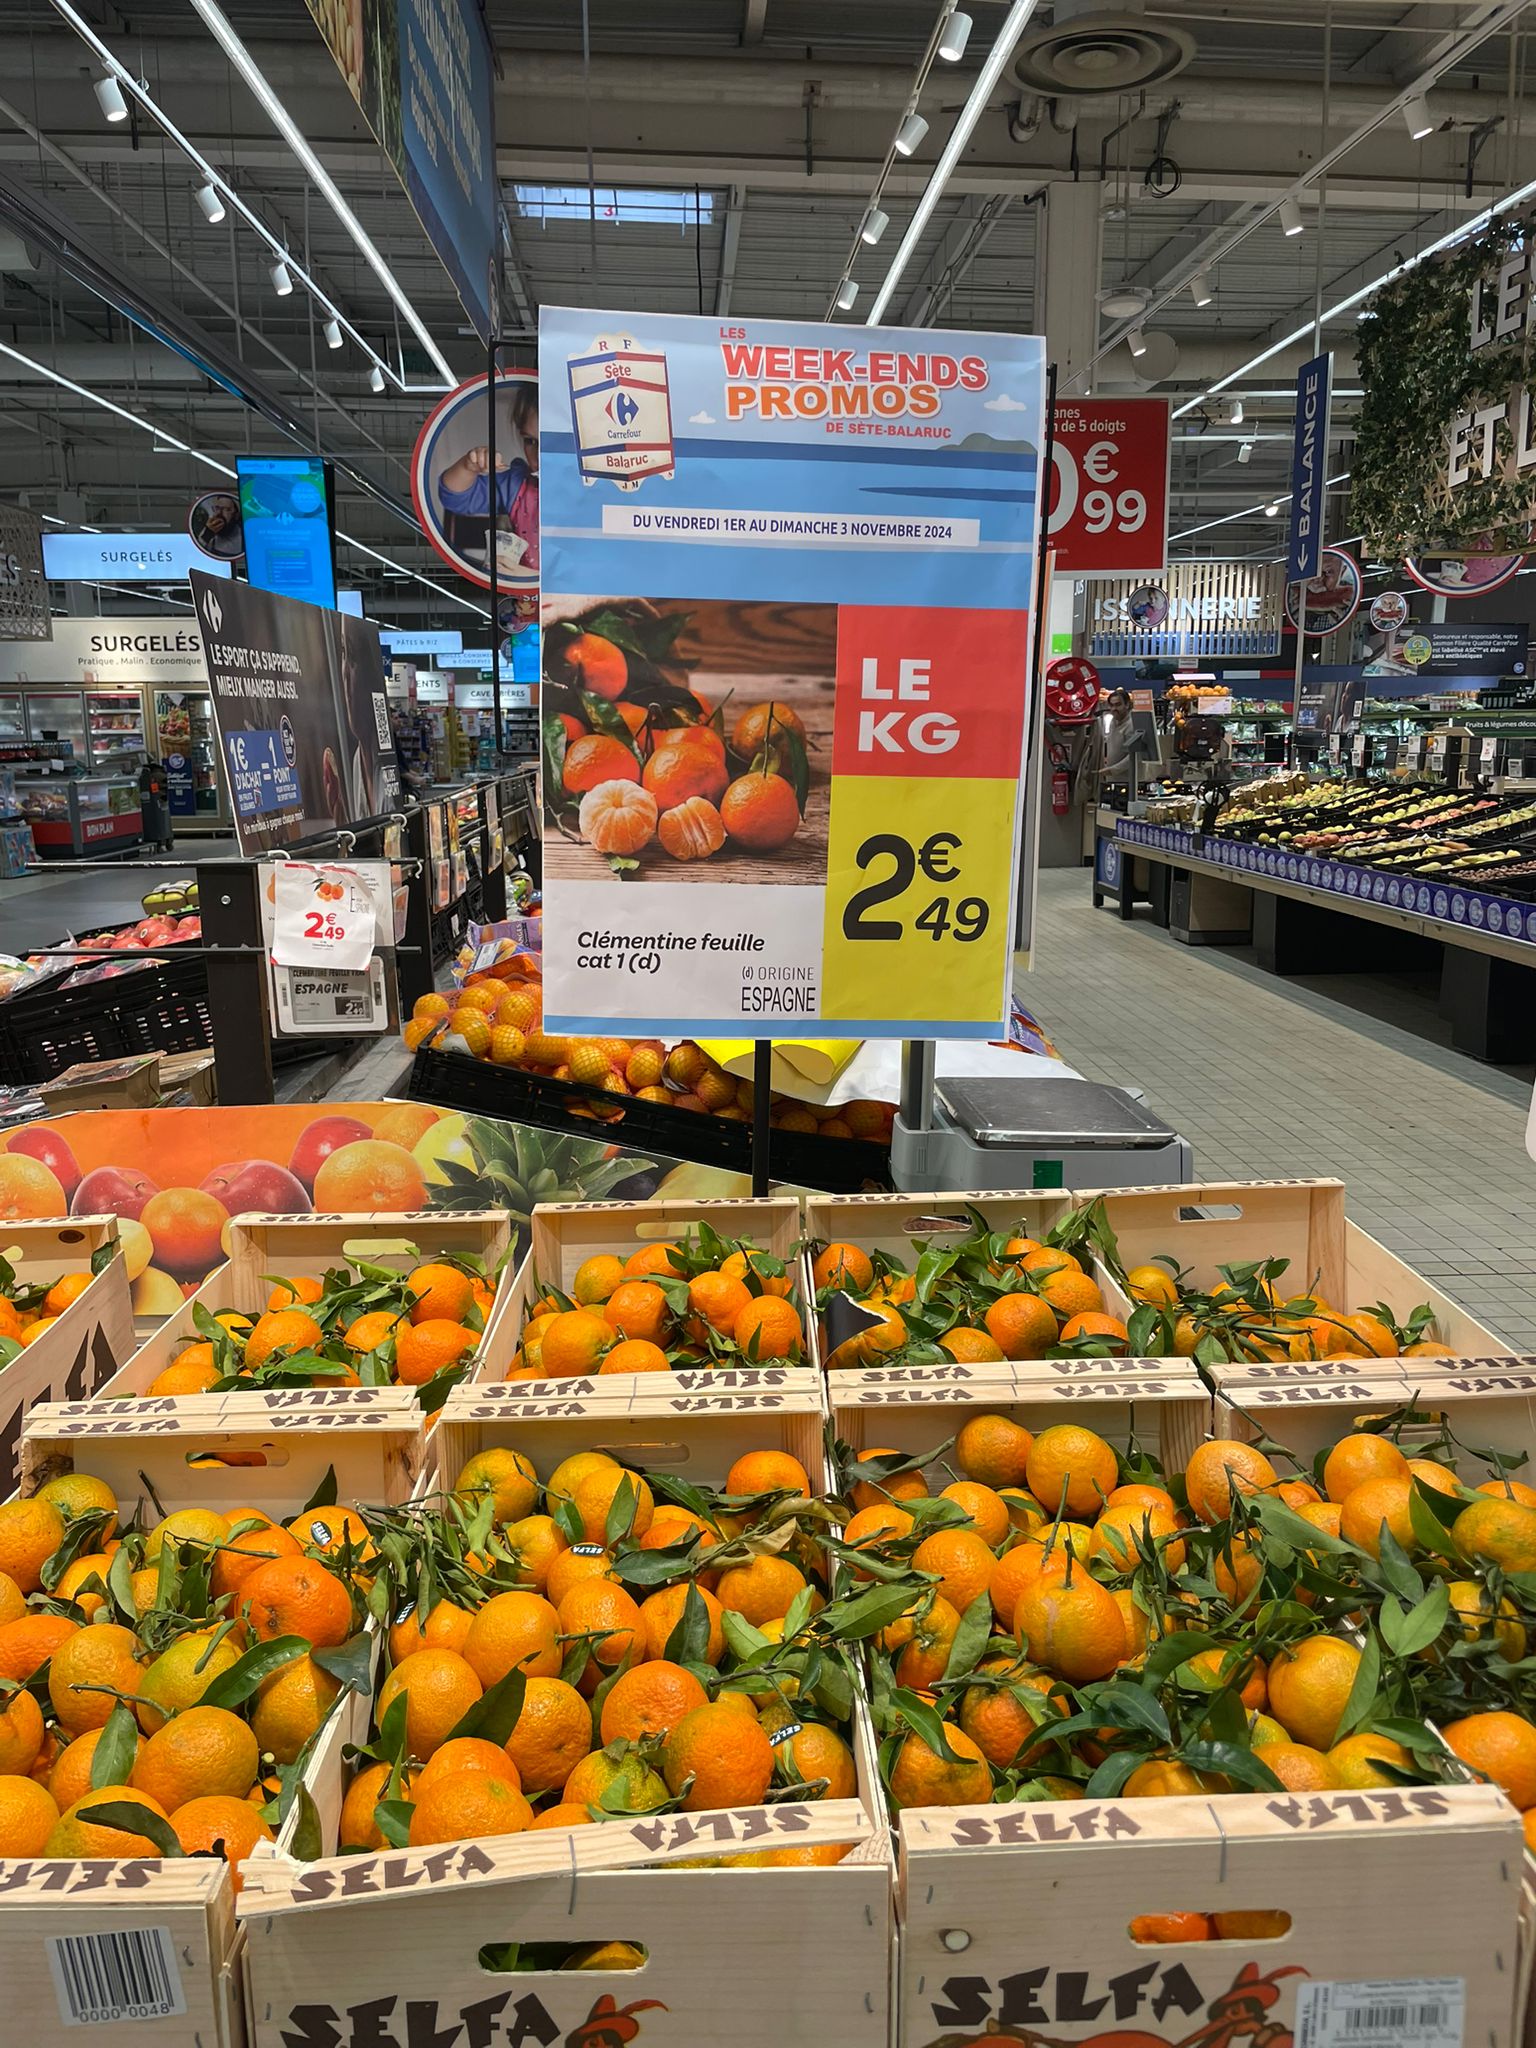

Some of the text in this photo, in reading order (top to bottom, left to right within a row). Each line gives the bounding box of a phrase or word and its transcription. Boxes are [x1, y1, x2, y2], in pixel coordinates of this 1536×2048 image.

[1470, 255, 1536, 350] LE
[720, 327, 746, 339] LES
[598, 339, 631, 351] R F
[604, 363, 632, 378] Sète
[721, 343, 988, 391] WEEK-ENDS
[727, 384, 940, 417] PROMOS
[1045, 408, 1080, 419] anes
[607, 429, 641, 439] Carrefour
[826, 421, 951, 438] DE SÈTE-BALARUC
[1061, 420, 1075, 432] de
[1079, 420, 1087, 432] 5
[1090, 420, 1126, 435] doigts
[606, 455, 649, 468] Balaruc
[1299, 372, 1318, 538] BALANCE
[1083, 490, 1147, 533] 99
[633, 514, 953, 539] DU VENDREDI 1ER AU DIMANCHE 3 NOVEMBRE 2024
[101, 551, 173, 562] SURGELÉS
[1094, 597, 1262, 621] ISSNNERIE
[91, 631, 200, 652] SURGELÉS
[78, 657, 201, 666] Pratique Malin Economique
[209, 643, 223, 666] LE
[222, 645, 249, 668] SPORT
[249, 649, 262, 674] ÇA
[216, 675, 245, 697] MIEUX
[243, 677, 277, 699] MANGER
[861, 657, 931, 701] LE
[857, 711, 961, 754] KG
[842, 832, 989, 942] 2 € 49
[304, 911, 325, 939] 2
[324, 927, 345, 940] 49
[577, 931, 765, 951] Clémentine feuille
[577, 953, 612, 969] cat
[758, 967, 815, 981] ORIGINE
[295, 983, 349, 995] ESPAGNE
[741, 987, 816, 1012] ESPAGNE
[260, 1215, 343, 1223] SELFA
[861, 1366, 974, 1382] SELFA
[1049, 1359, 1163, 1375] SELFA
[1247, 1363, 1361, 1377] SELFA
[481, 1379, 596, 1399] SELFA
[675, 1370, 788, 1390] SELFA
[263, 1390, 380, 1408] SELFA
[858, 1388, 974, 1403] SELFA
[1053, 1382, 1168, 1398] SELFA
[1257, 1384, 1374, 1403] SELFA
[58, 1398, 179, 1416] SELFA
[469, 1402, 587, 1418] SELFA
[670, 1395, 785, 1412] SELFA
[57, 1419, 181, 1434] SELFA
[268, 1413, 389, 1428] SELFA
[1265, 1791, 1449, 1829] SELFA
[629, 1805, 813, 1852] SELFA
[950, 1806, 1142, 1846] SELFA
[0, 1860, 162, 1894] SELF
[291, 1845, 496, 1903] SELFA
[931, 1961, 1205, 2027] SELFA
[79, 2002, 170, 2023] 0000 0048
[280, 1989, 561, 2048] SELFA
